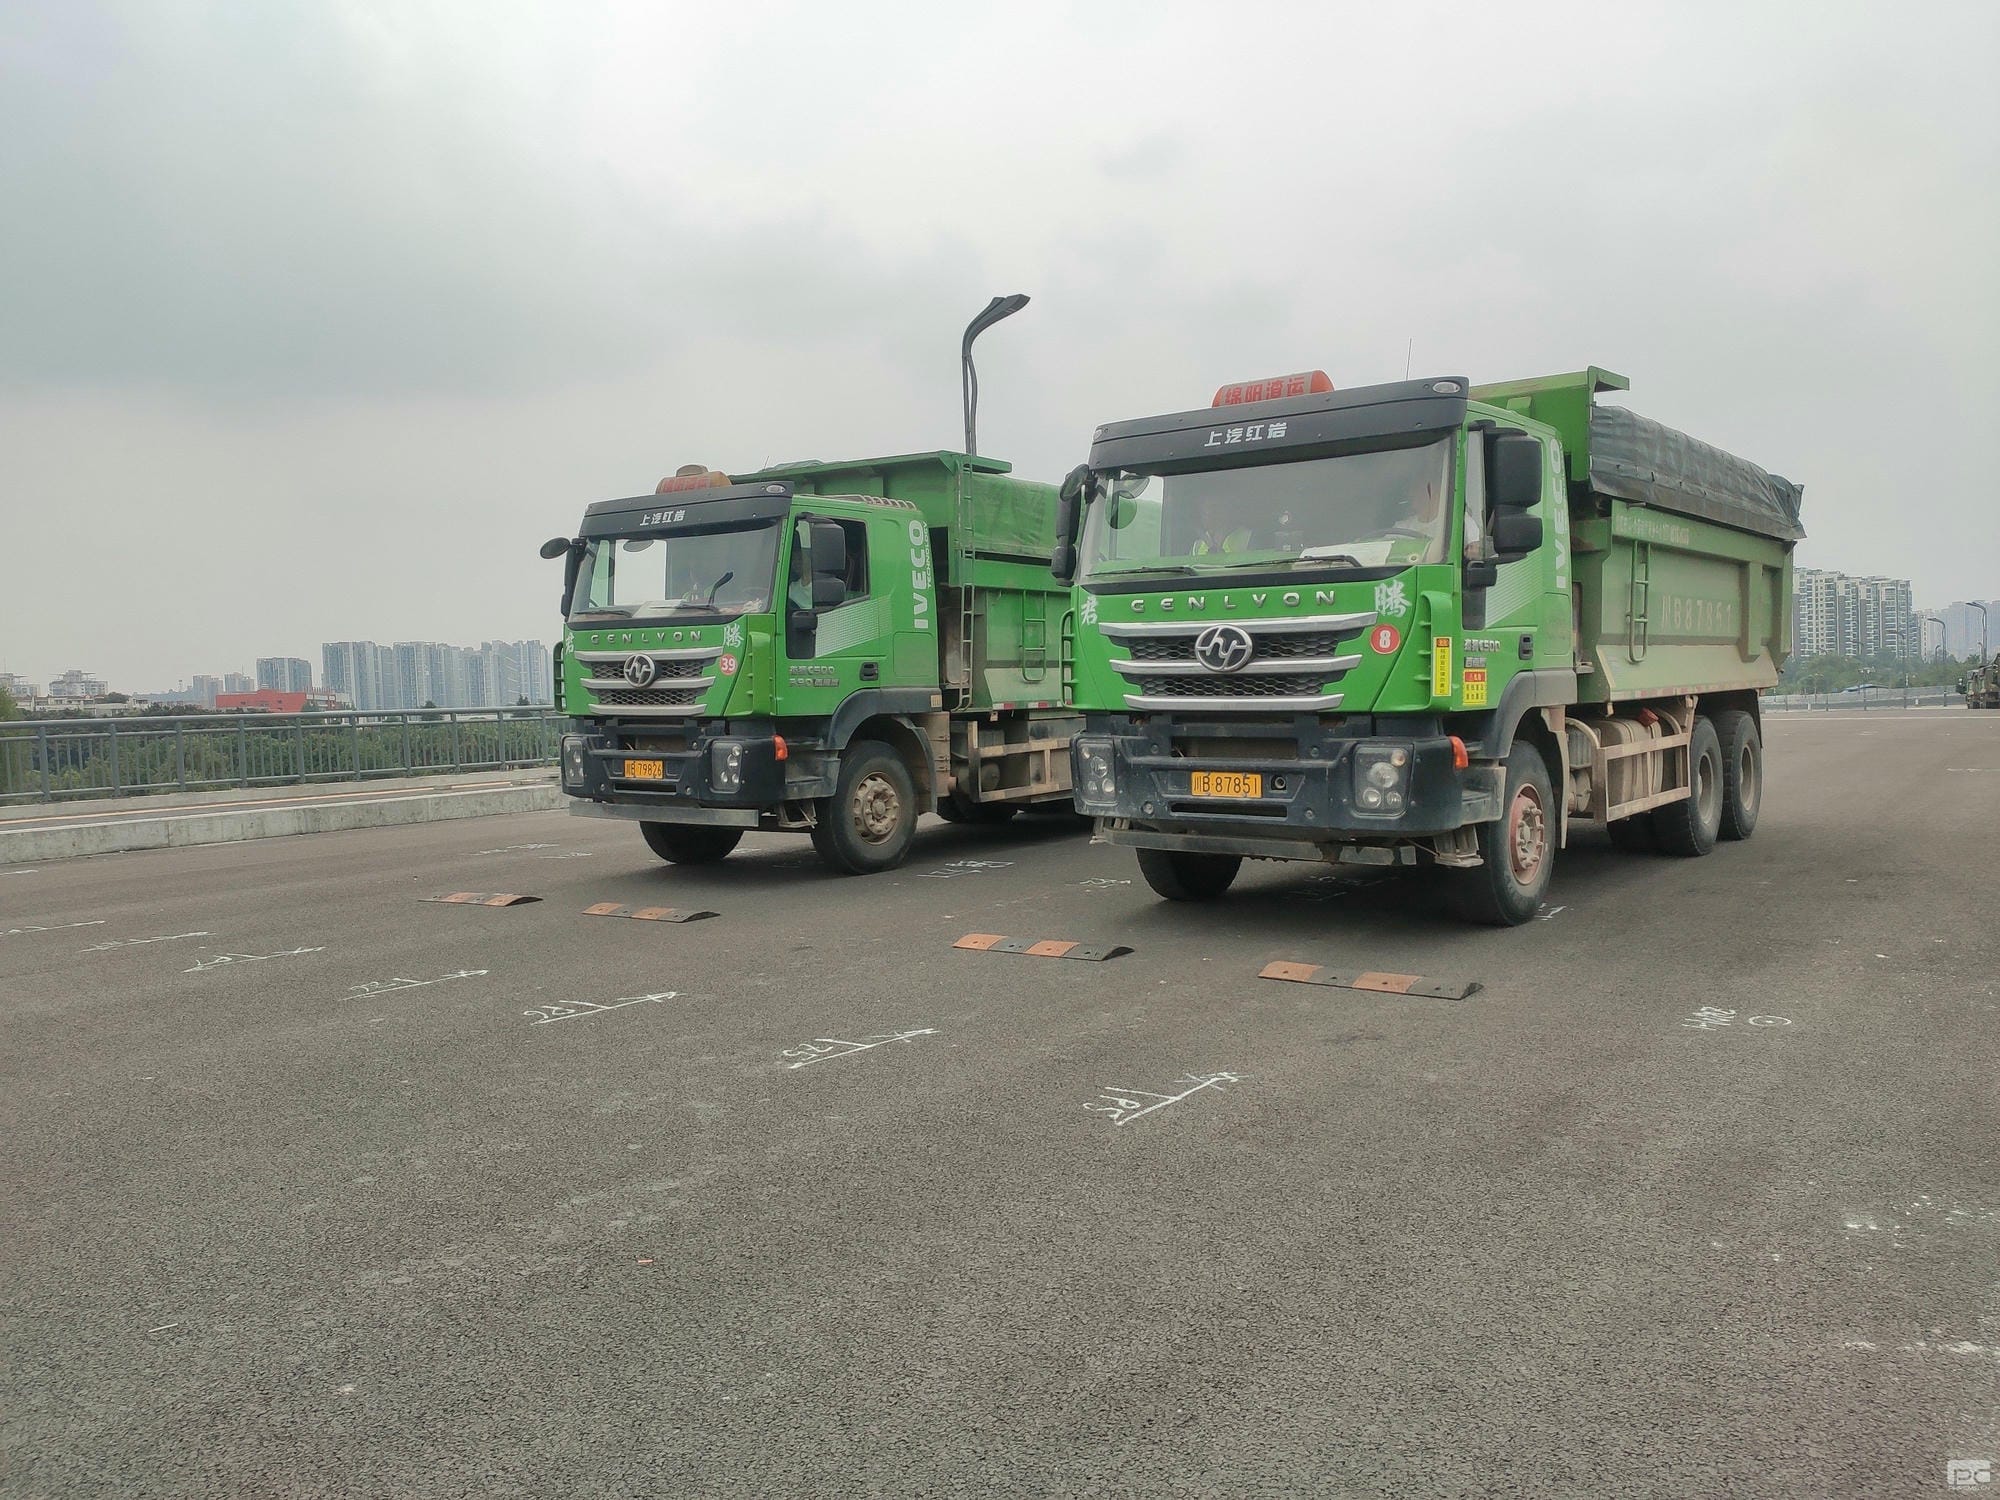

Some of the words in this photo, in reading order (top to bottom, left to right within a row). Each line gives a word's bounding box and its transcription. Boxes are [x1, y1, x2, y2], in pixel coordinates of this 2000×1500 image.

[1225, 377, 1305, 405] 绵阳渣运
[1204, 422, 1288, 447] 上汽红岩
[640, 510, 686, 526] 上汽红岩
[1550, 438, 1566, 589] IVECO
[909, 520, 928, 629] IVECO
[1131, 590, 1335, 614] GENLYON
[590, 630, 702, 645] GENLYON
[1378, 629, 1392, 648] 8
[720, 657, 737, 673] 39
